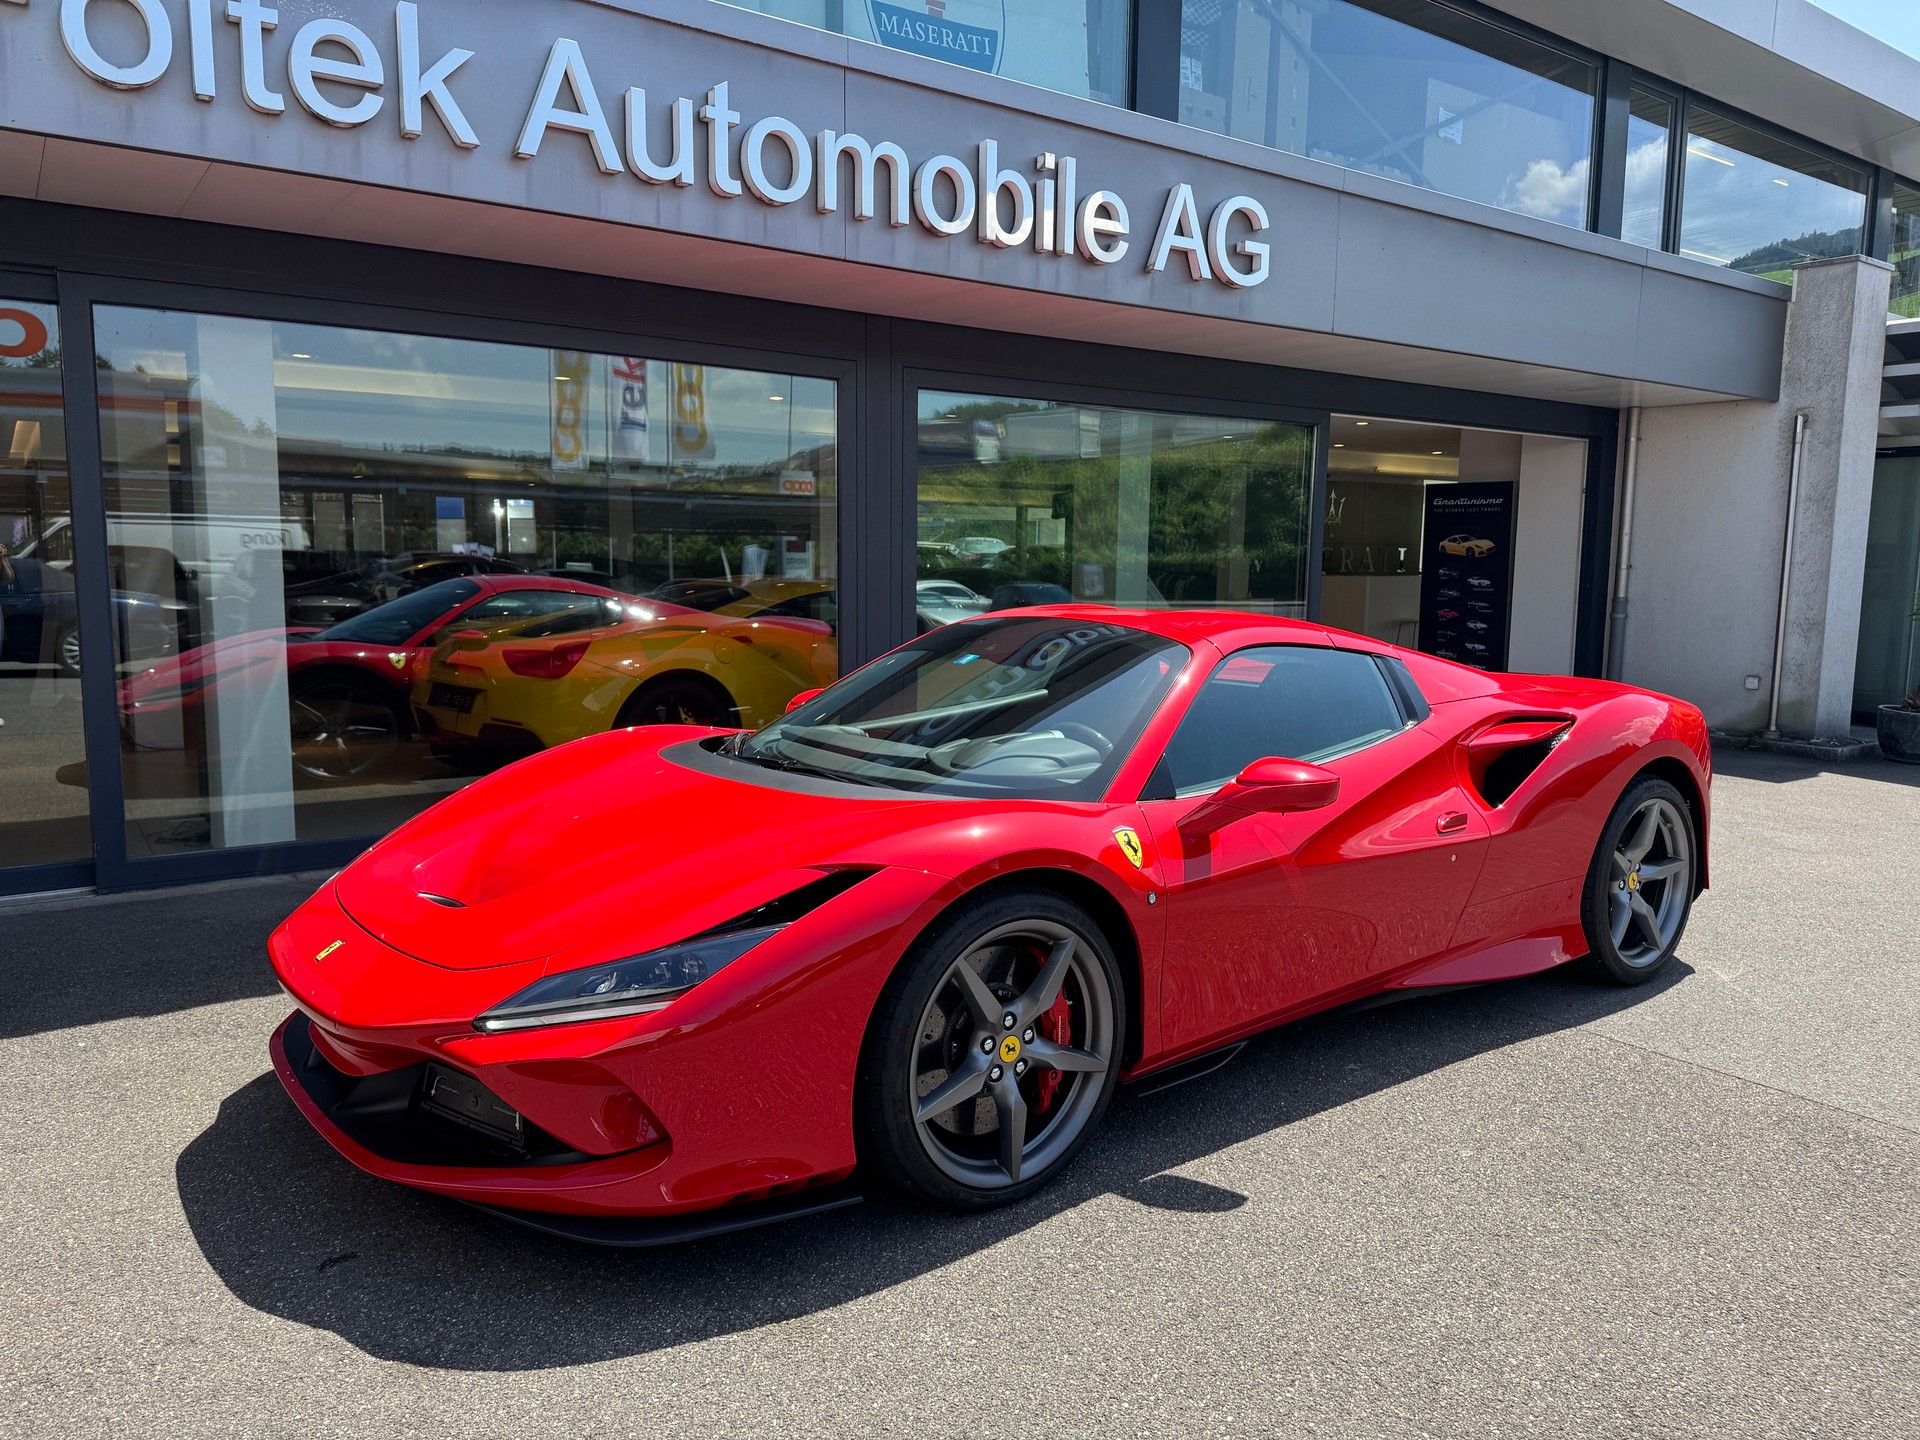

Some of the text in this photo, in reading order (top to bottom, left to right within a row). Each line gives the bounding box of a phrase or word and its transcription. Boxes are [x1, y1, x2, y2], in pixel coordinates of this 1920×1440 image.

[879, 11, 992, 56] MASERATI
[513, 37, 1130, 265] Automobile
[1144, 183, 1270, 289] AG
